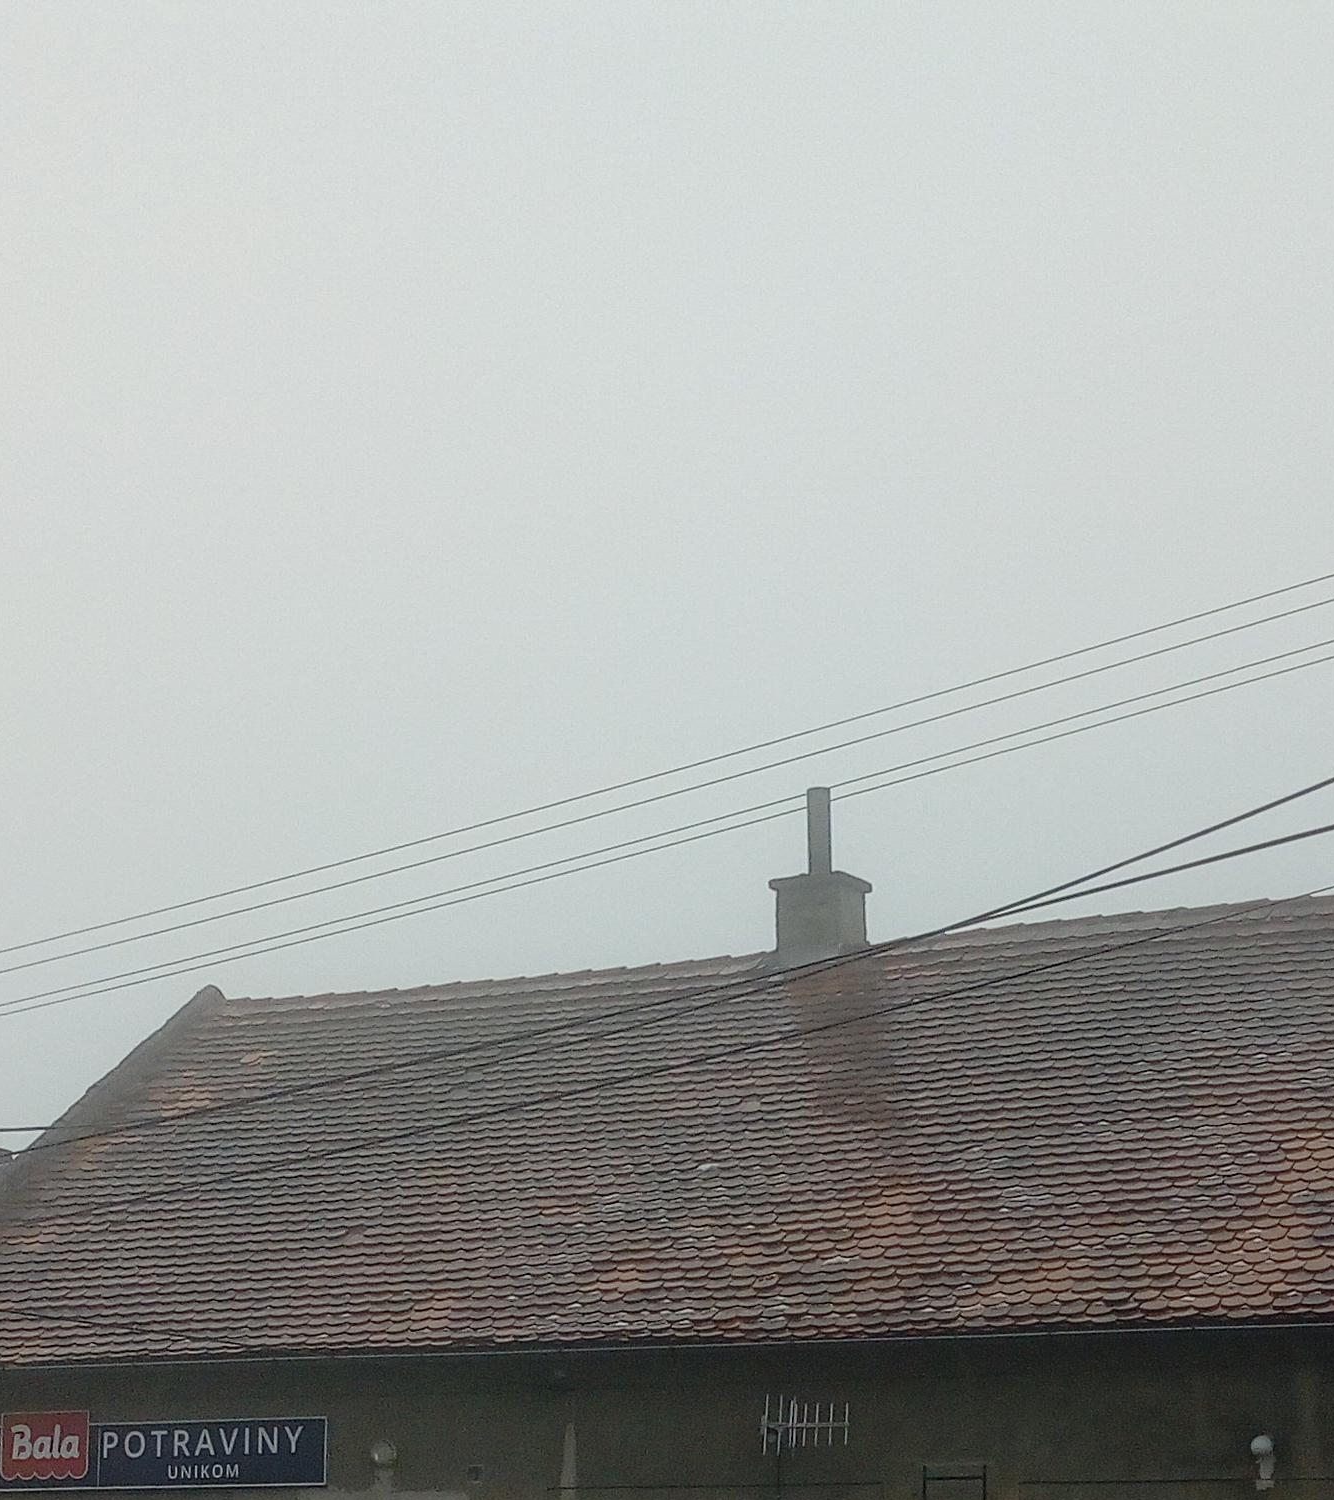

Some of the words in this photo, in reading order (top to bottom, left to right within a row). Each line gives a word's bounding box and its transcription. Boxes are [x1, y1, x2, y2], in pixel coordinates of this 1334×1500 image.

[10, 1423, 80, 1461] Bala
[102, 1425, 304, 1459] POTRAVINY
[167, 1463, 239, 1480] UNIKOM
